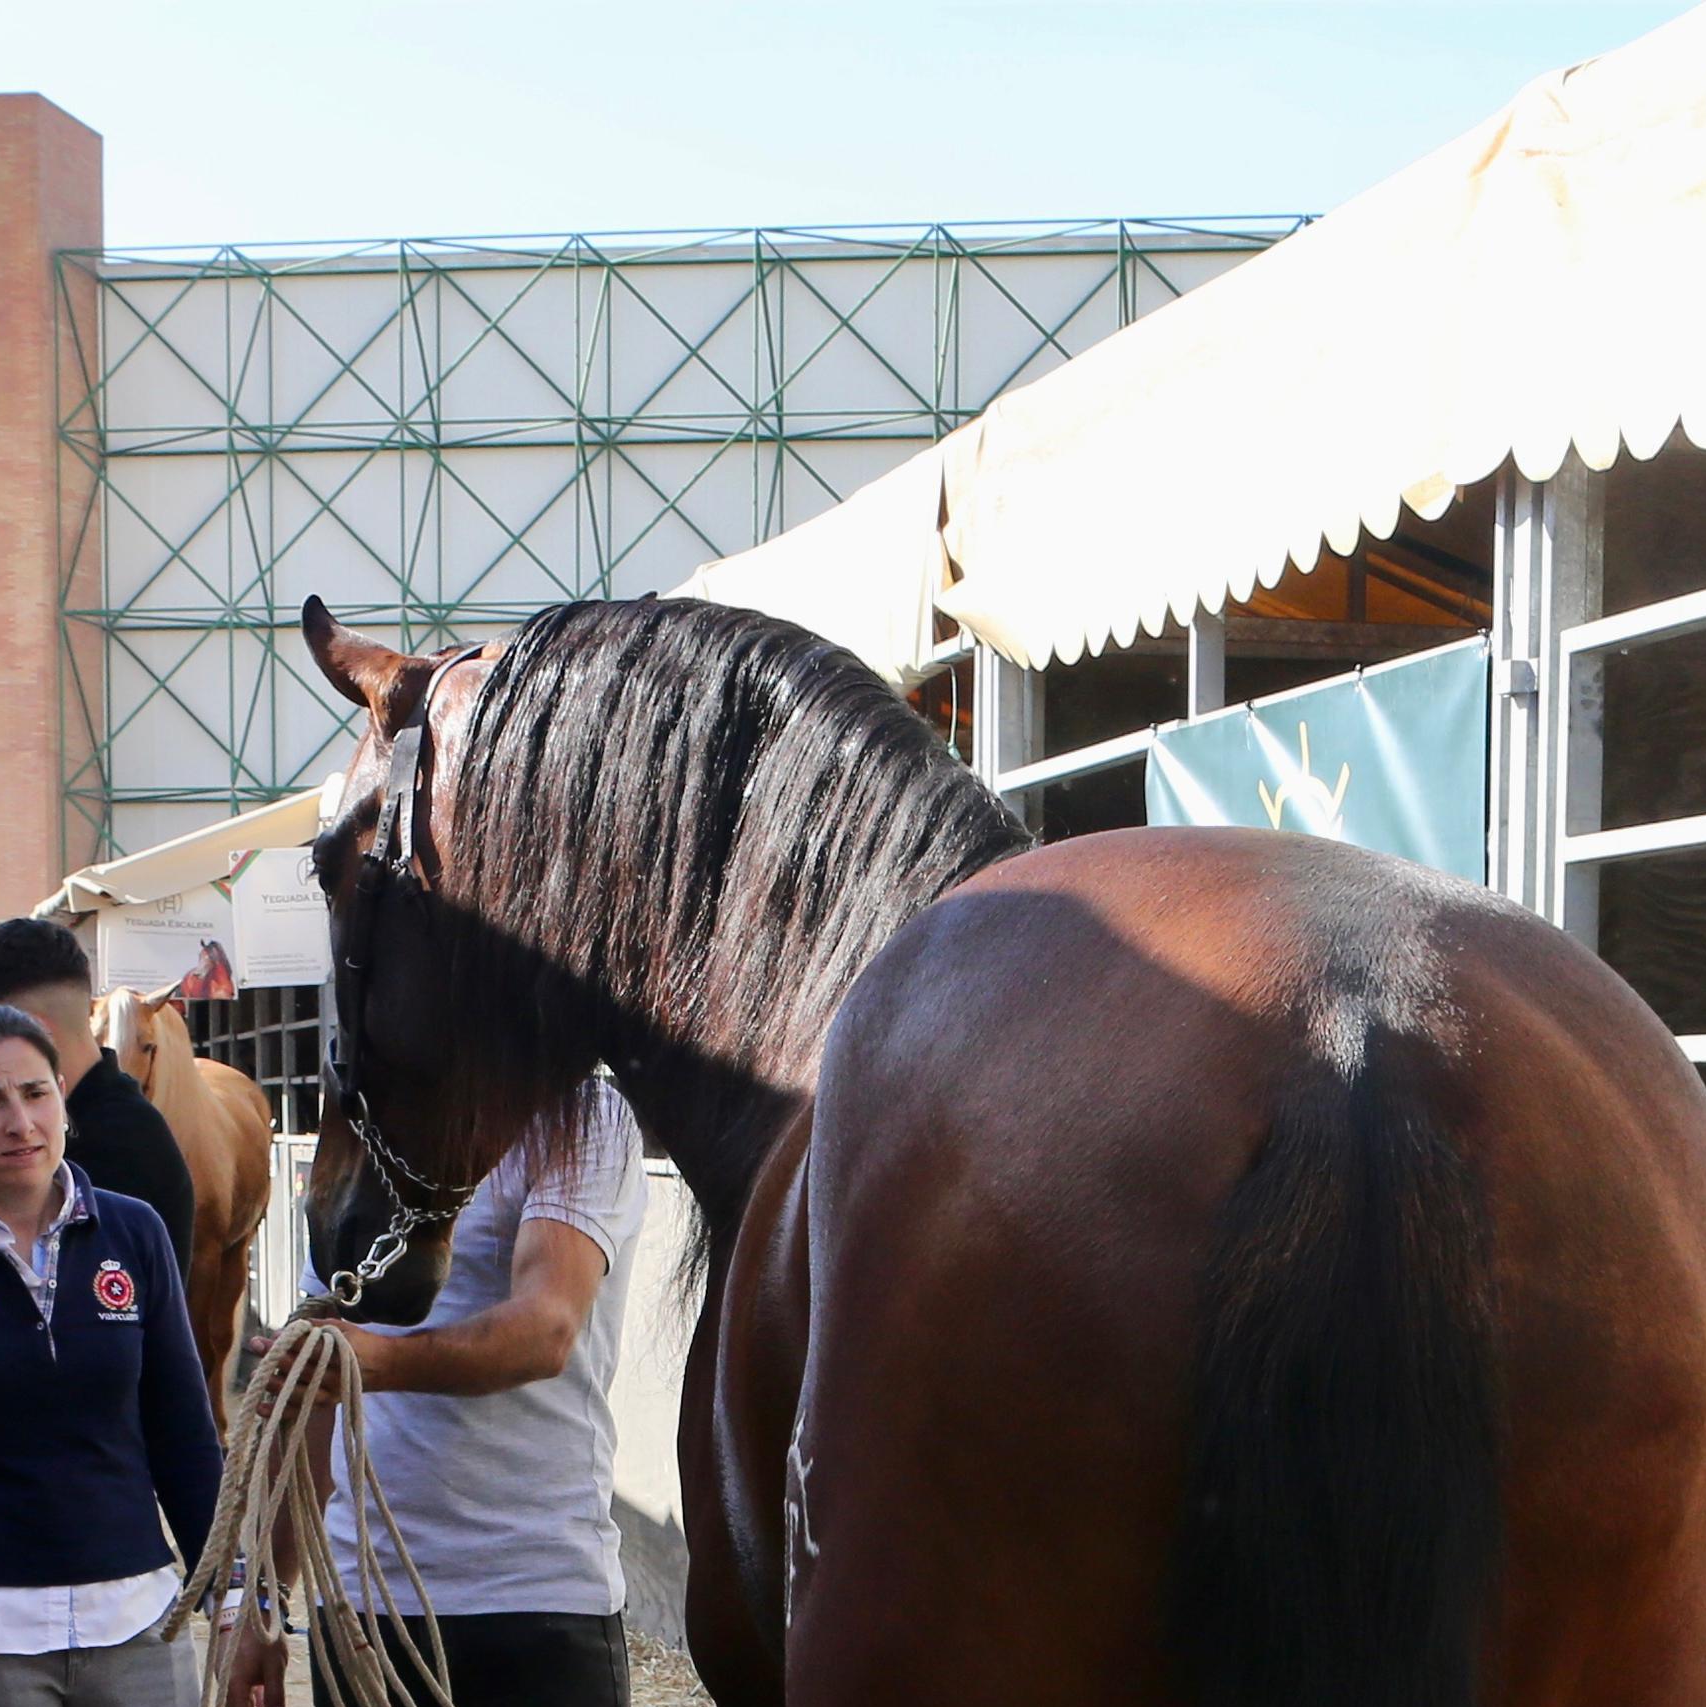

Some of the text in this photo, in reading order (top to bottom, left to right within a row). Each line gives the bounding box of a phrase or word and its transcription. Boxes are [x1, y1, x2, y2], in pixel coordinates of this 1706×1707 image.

[260, 893, 310, 904] YEGUADA
[124, 917, 214, 929] YEGUADA ESCALERA
